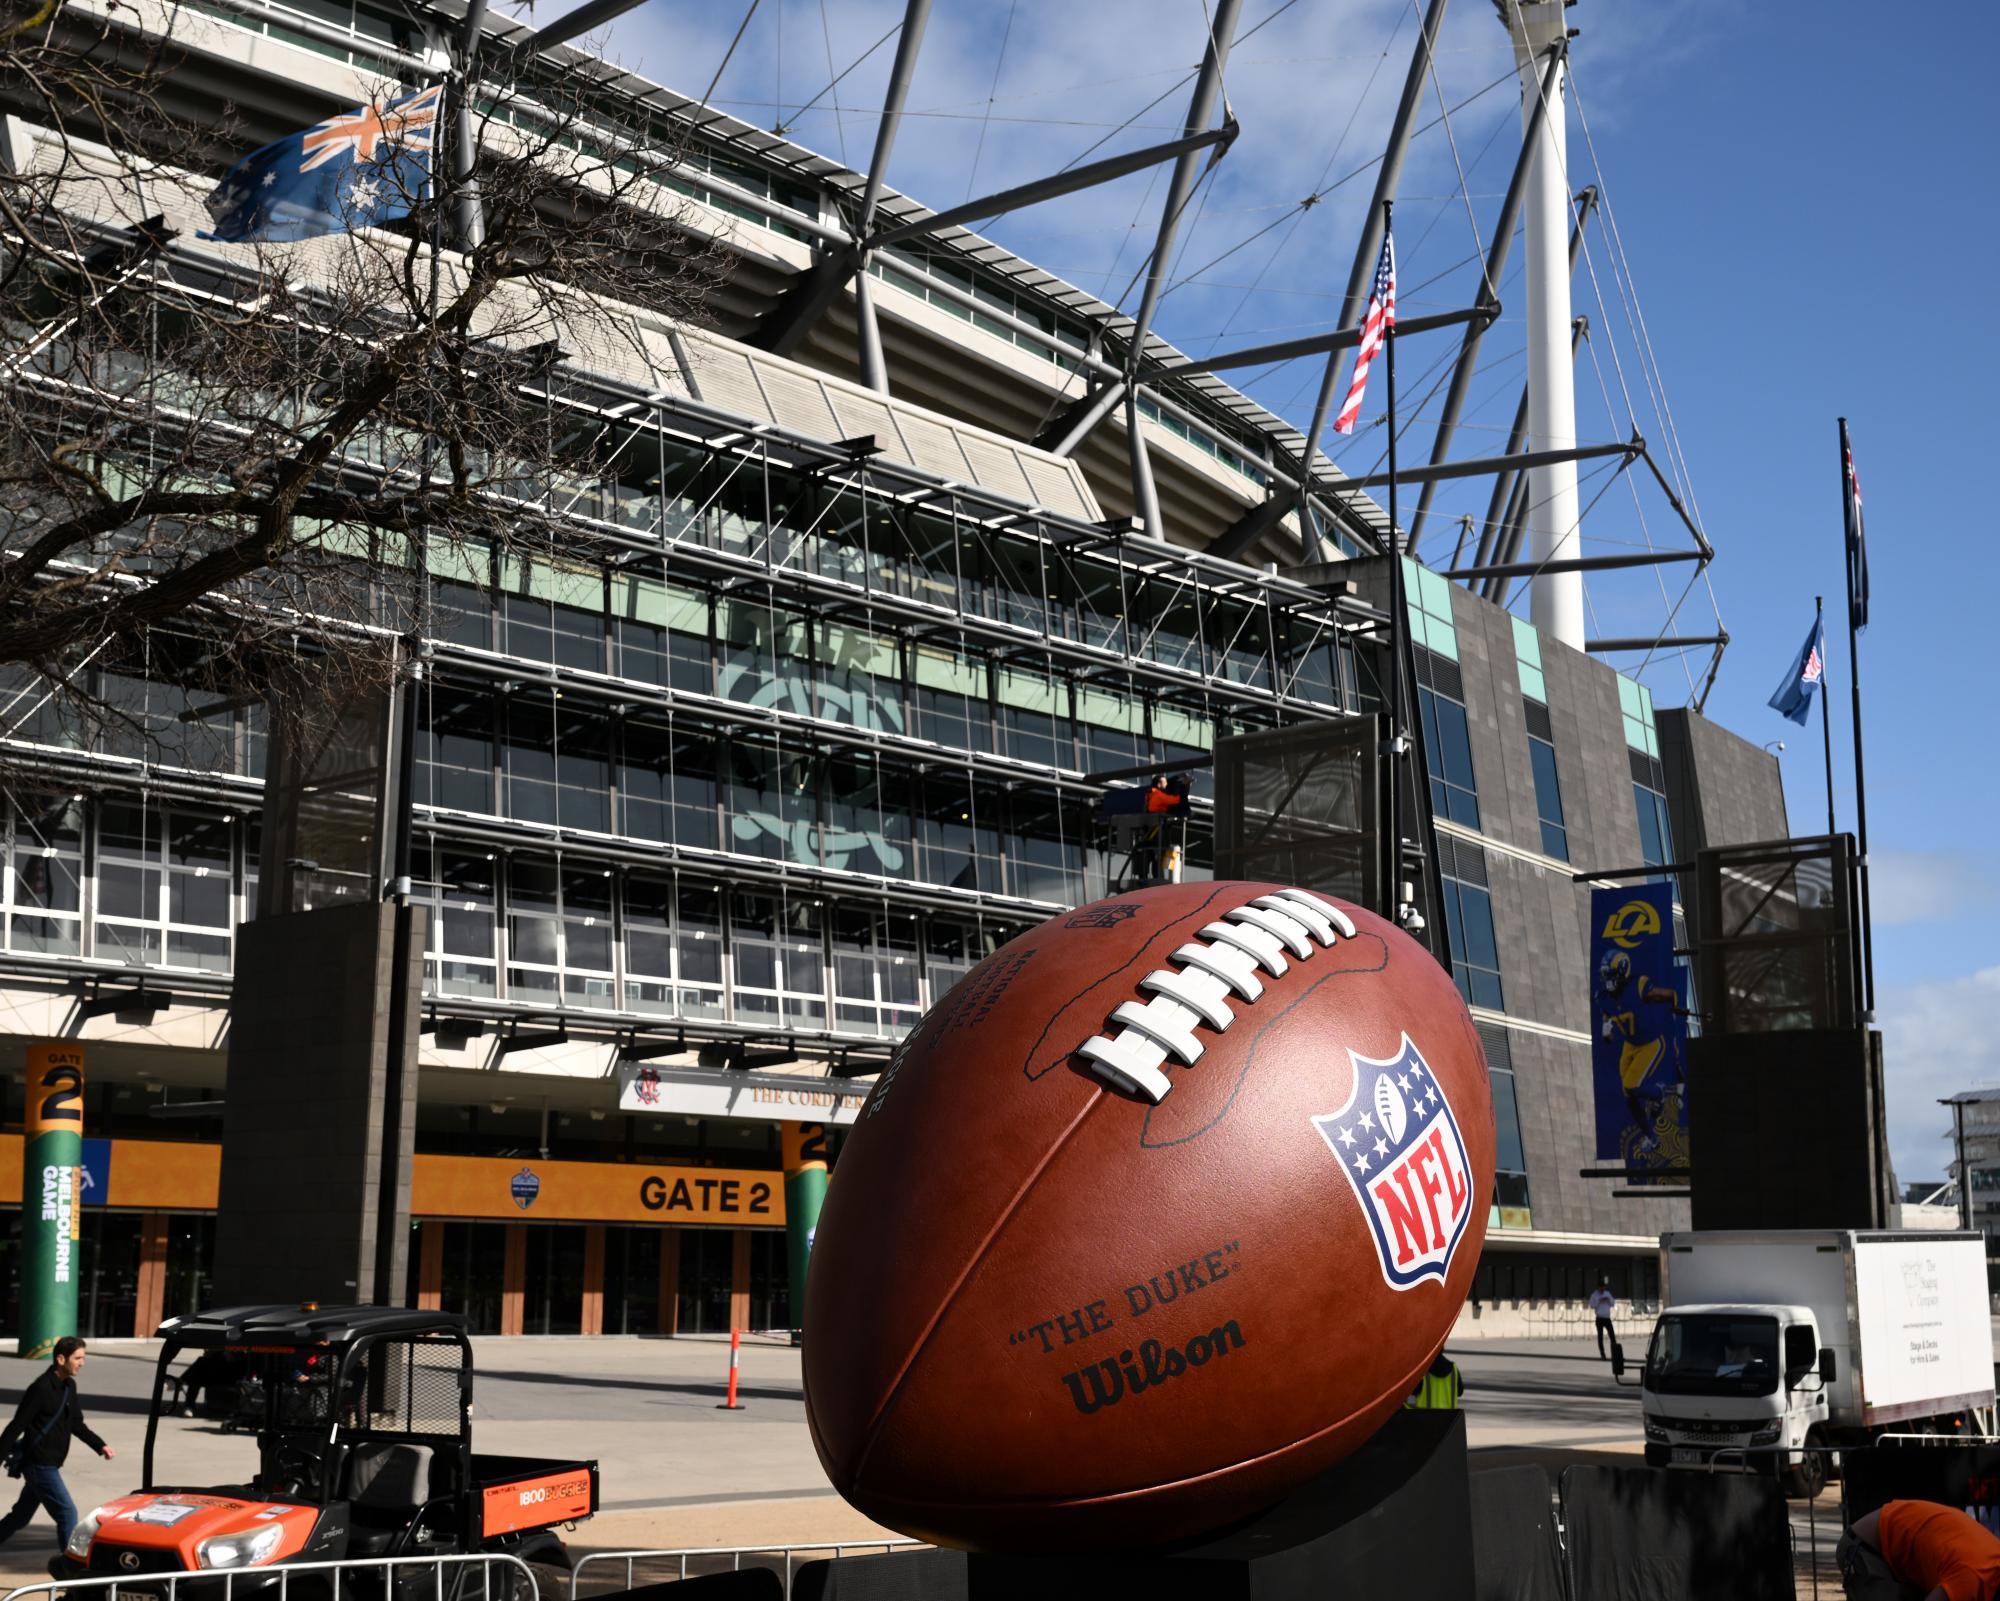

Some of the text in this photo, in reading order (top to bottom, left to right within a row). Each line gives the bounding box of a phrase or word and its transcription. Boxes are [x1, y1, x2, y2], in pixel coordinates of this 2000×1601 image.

[42, 1065, 82, 1120] 2
[752, 1086, 784, 1105] THE
[799, 1120, 831, 1160] 2
[42, 1165, 58, 1220] GAME
[640, 1176, 770, 1213] GATE 2
[1374, 1127, 1466, 1265] NFL
[55, 1165, 72, 1282] MELBOURNE
[1062, 1320, 1247, 1414] Wilson
